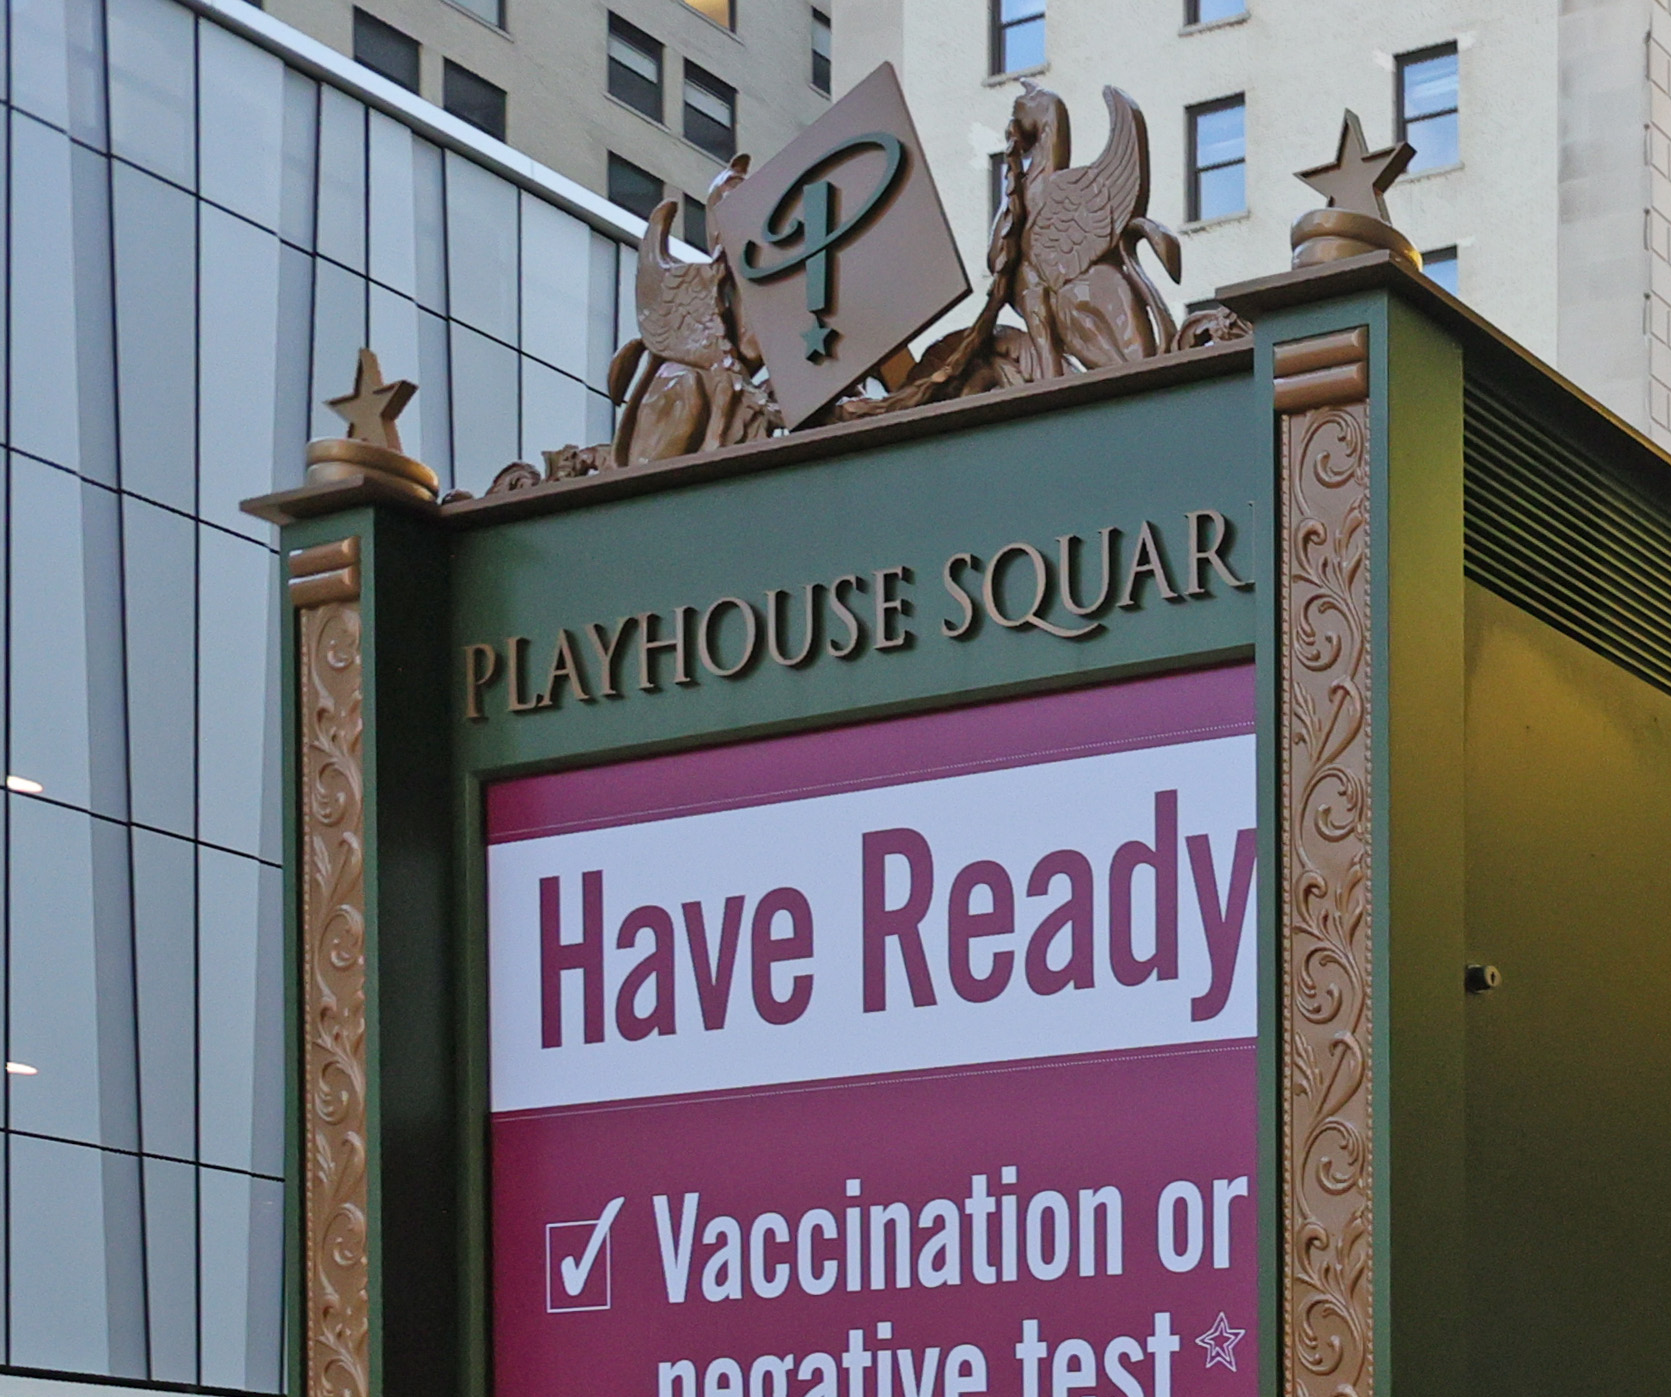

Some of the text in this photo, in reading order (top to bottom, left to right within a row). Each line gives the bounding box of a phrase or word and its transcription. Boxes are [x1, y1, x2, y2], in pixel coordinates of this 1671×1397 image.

[462, 500, 1255, 722] PLAYHOUSE SQUAR
[538, 788, 1258, 1050] Have Ready
[652, 1165, 1249, 1304] Vaccination or
